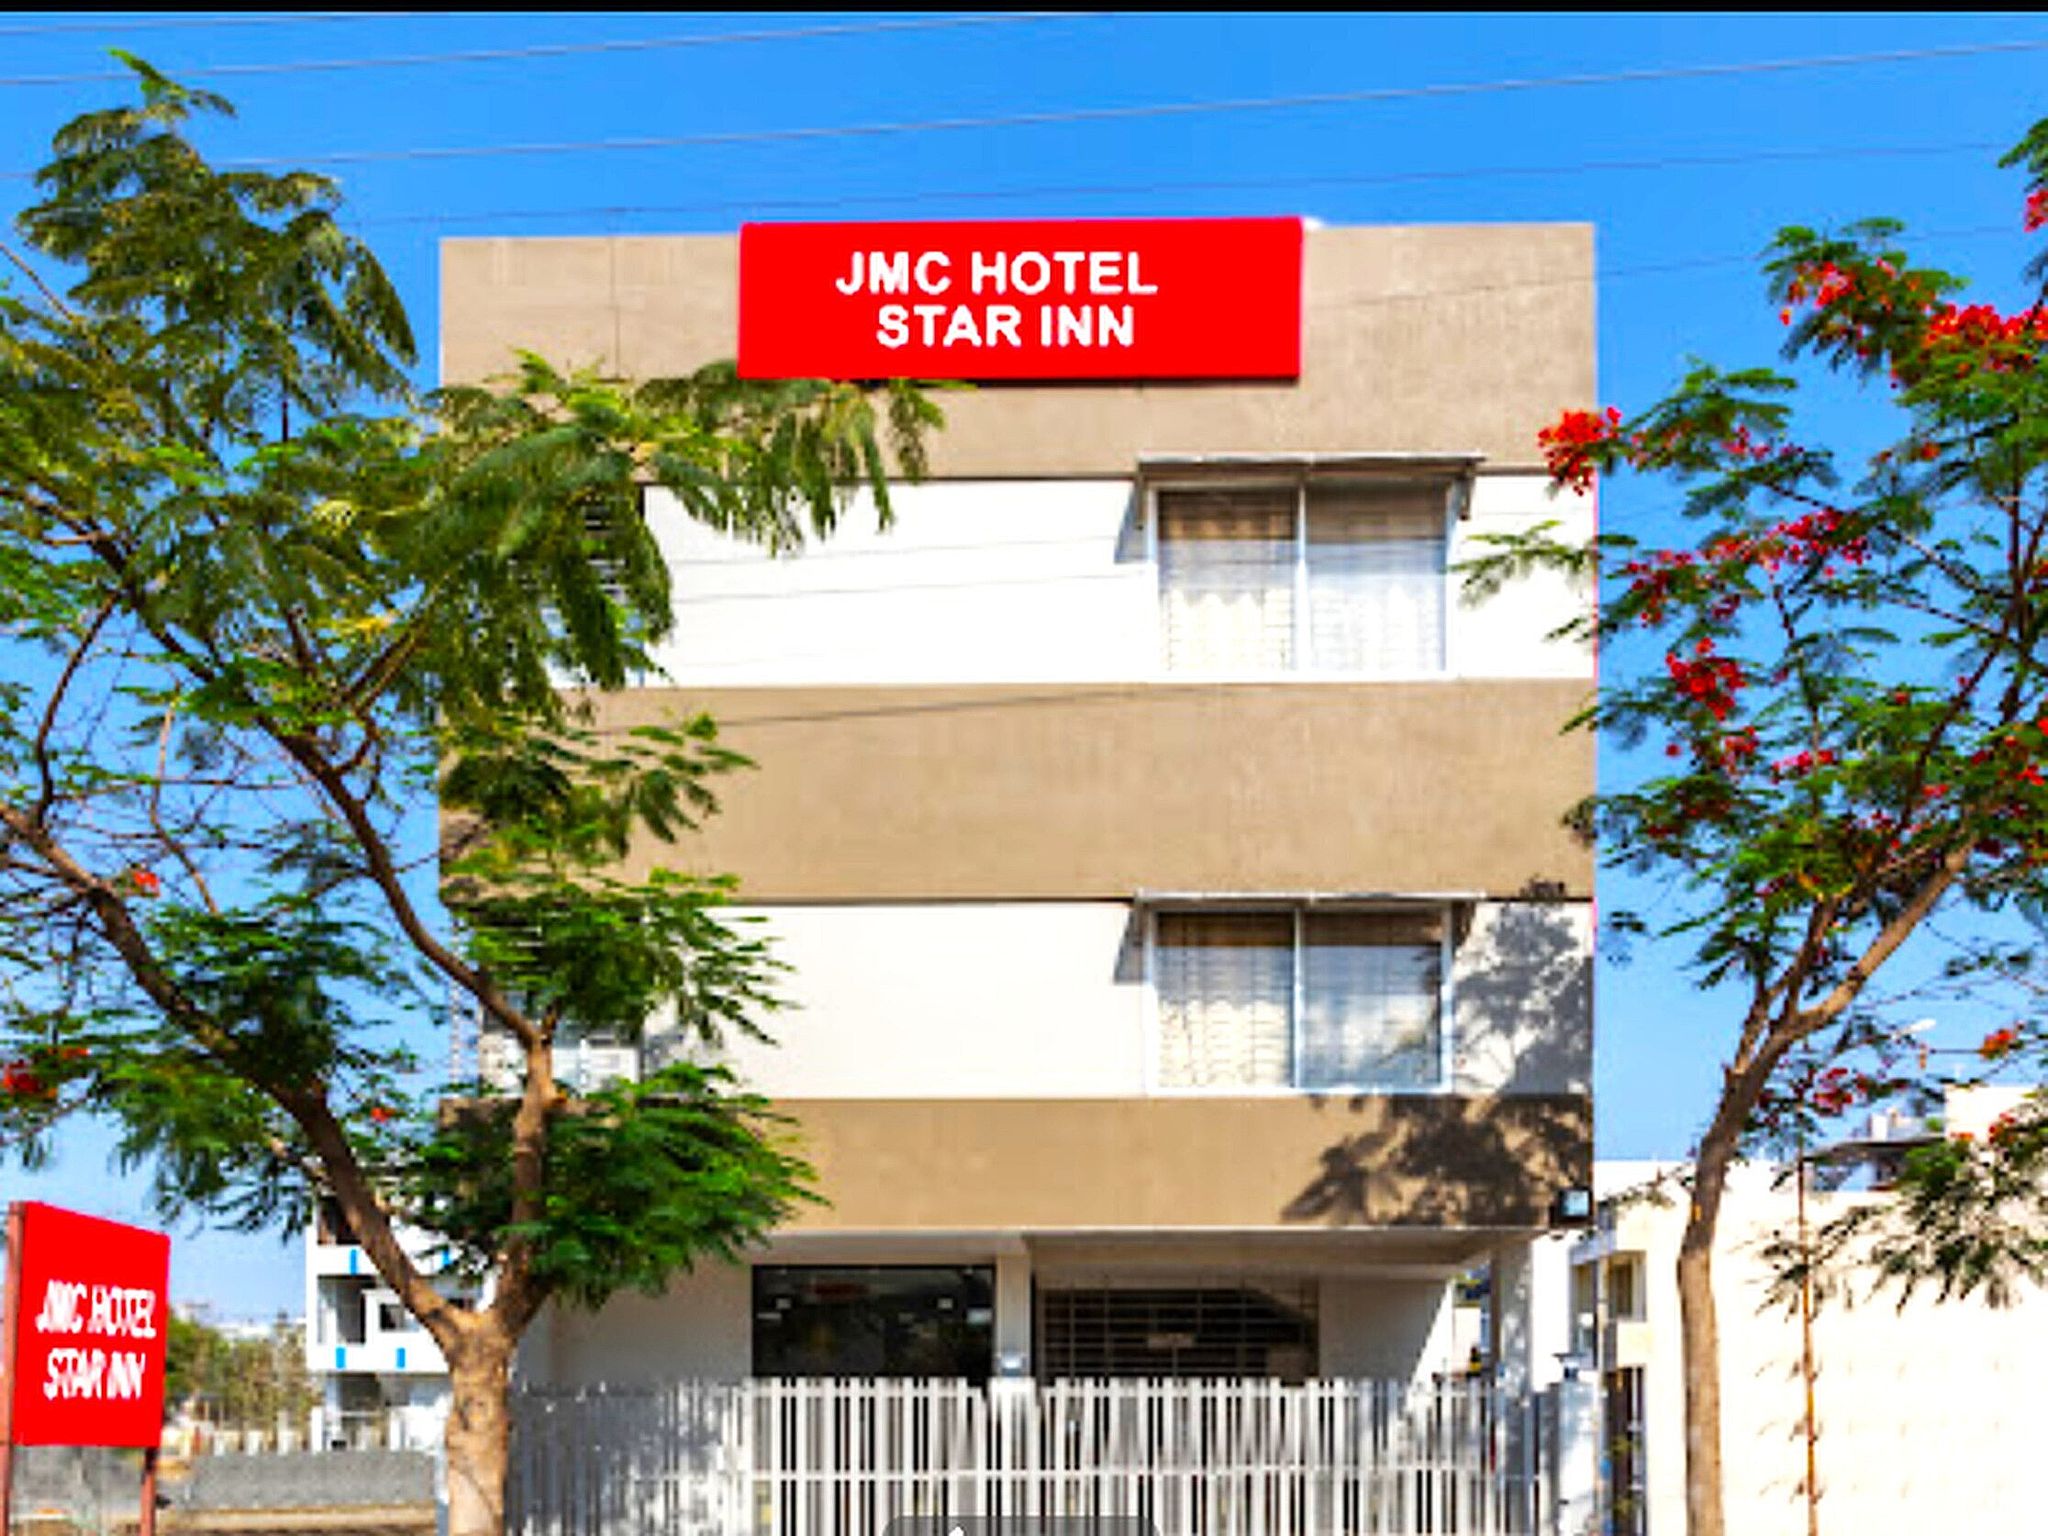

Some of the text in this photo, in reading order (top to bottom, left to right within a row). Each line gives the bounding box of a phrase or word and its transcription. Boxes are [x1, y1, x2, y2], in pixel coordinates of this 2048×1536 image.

[836, 251, 1158, 295] JMC HOTEL
[876, 304, 1134, 348] STAR INN
[35, 1280, 156, 1338] JMC HOTEL
[43, 1347, 106, 1400] STAR
